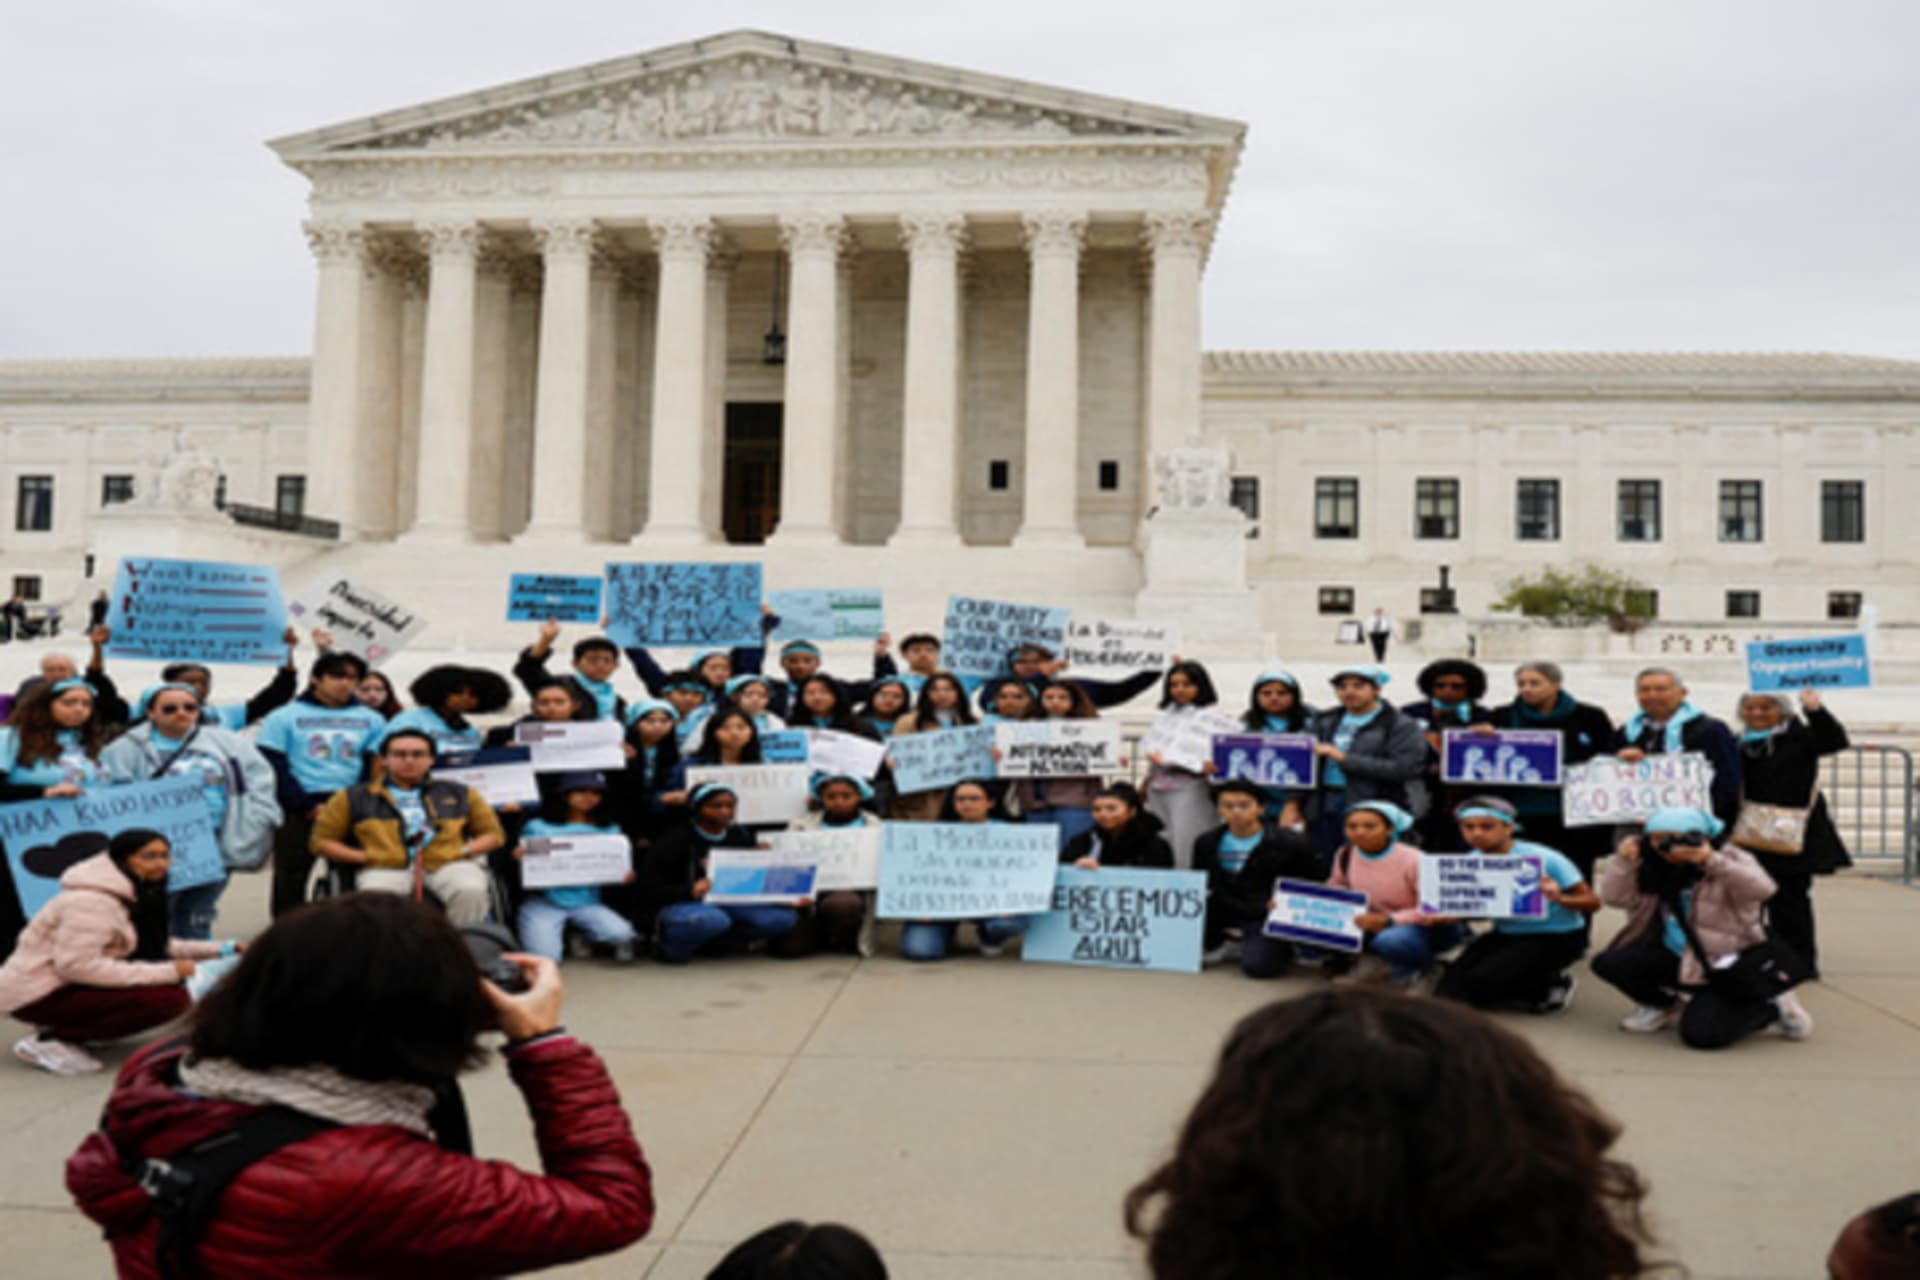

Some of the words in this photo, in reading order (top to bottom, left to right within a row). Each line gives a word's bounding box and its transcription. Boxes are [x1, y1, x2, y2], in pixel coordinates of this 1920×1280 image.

[956, 599, 994, 617] OUR
[1764, 640, 1847, 658] Diversity
[1751, 656, 1863, 675] Opportunity
[1779, 674, 1841, 688] Justice
[1458, 859, 1479, 870] THE
[1483, 859, 1522, 871] RIGHT
[1051, 884, 1203, 920] ERECEMOS
[1439, 887, 1495, 899] SUPREME
[1070, 912, 1151, 937] ESTAR
